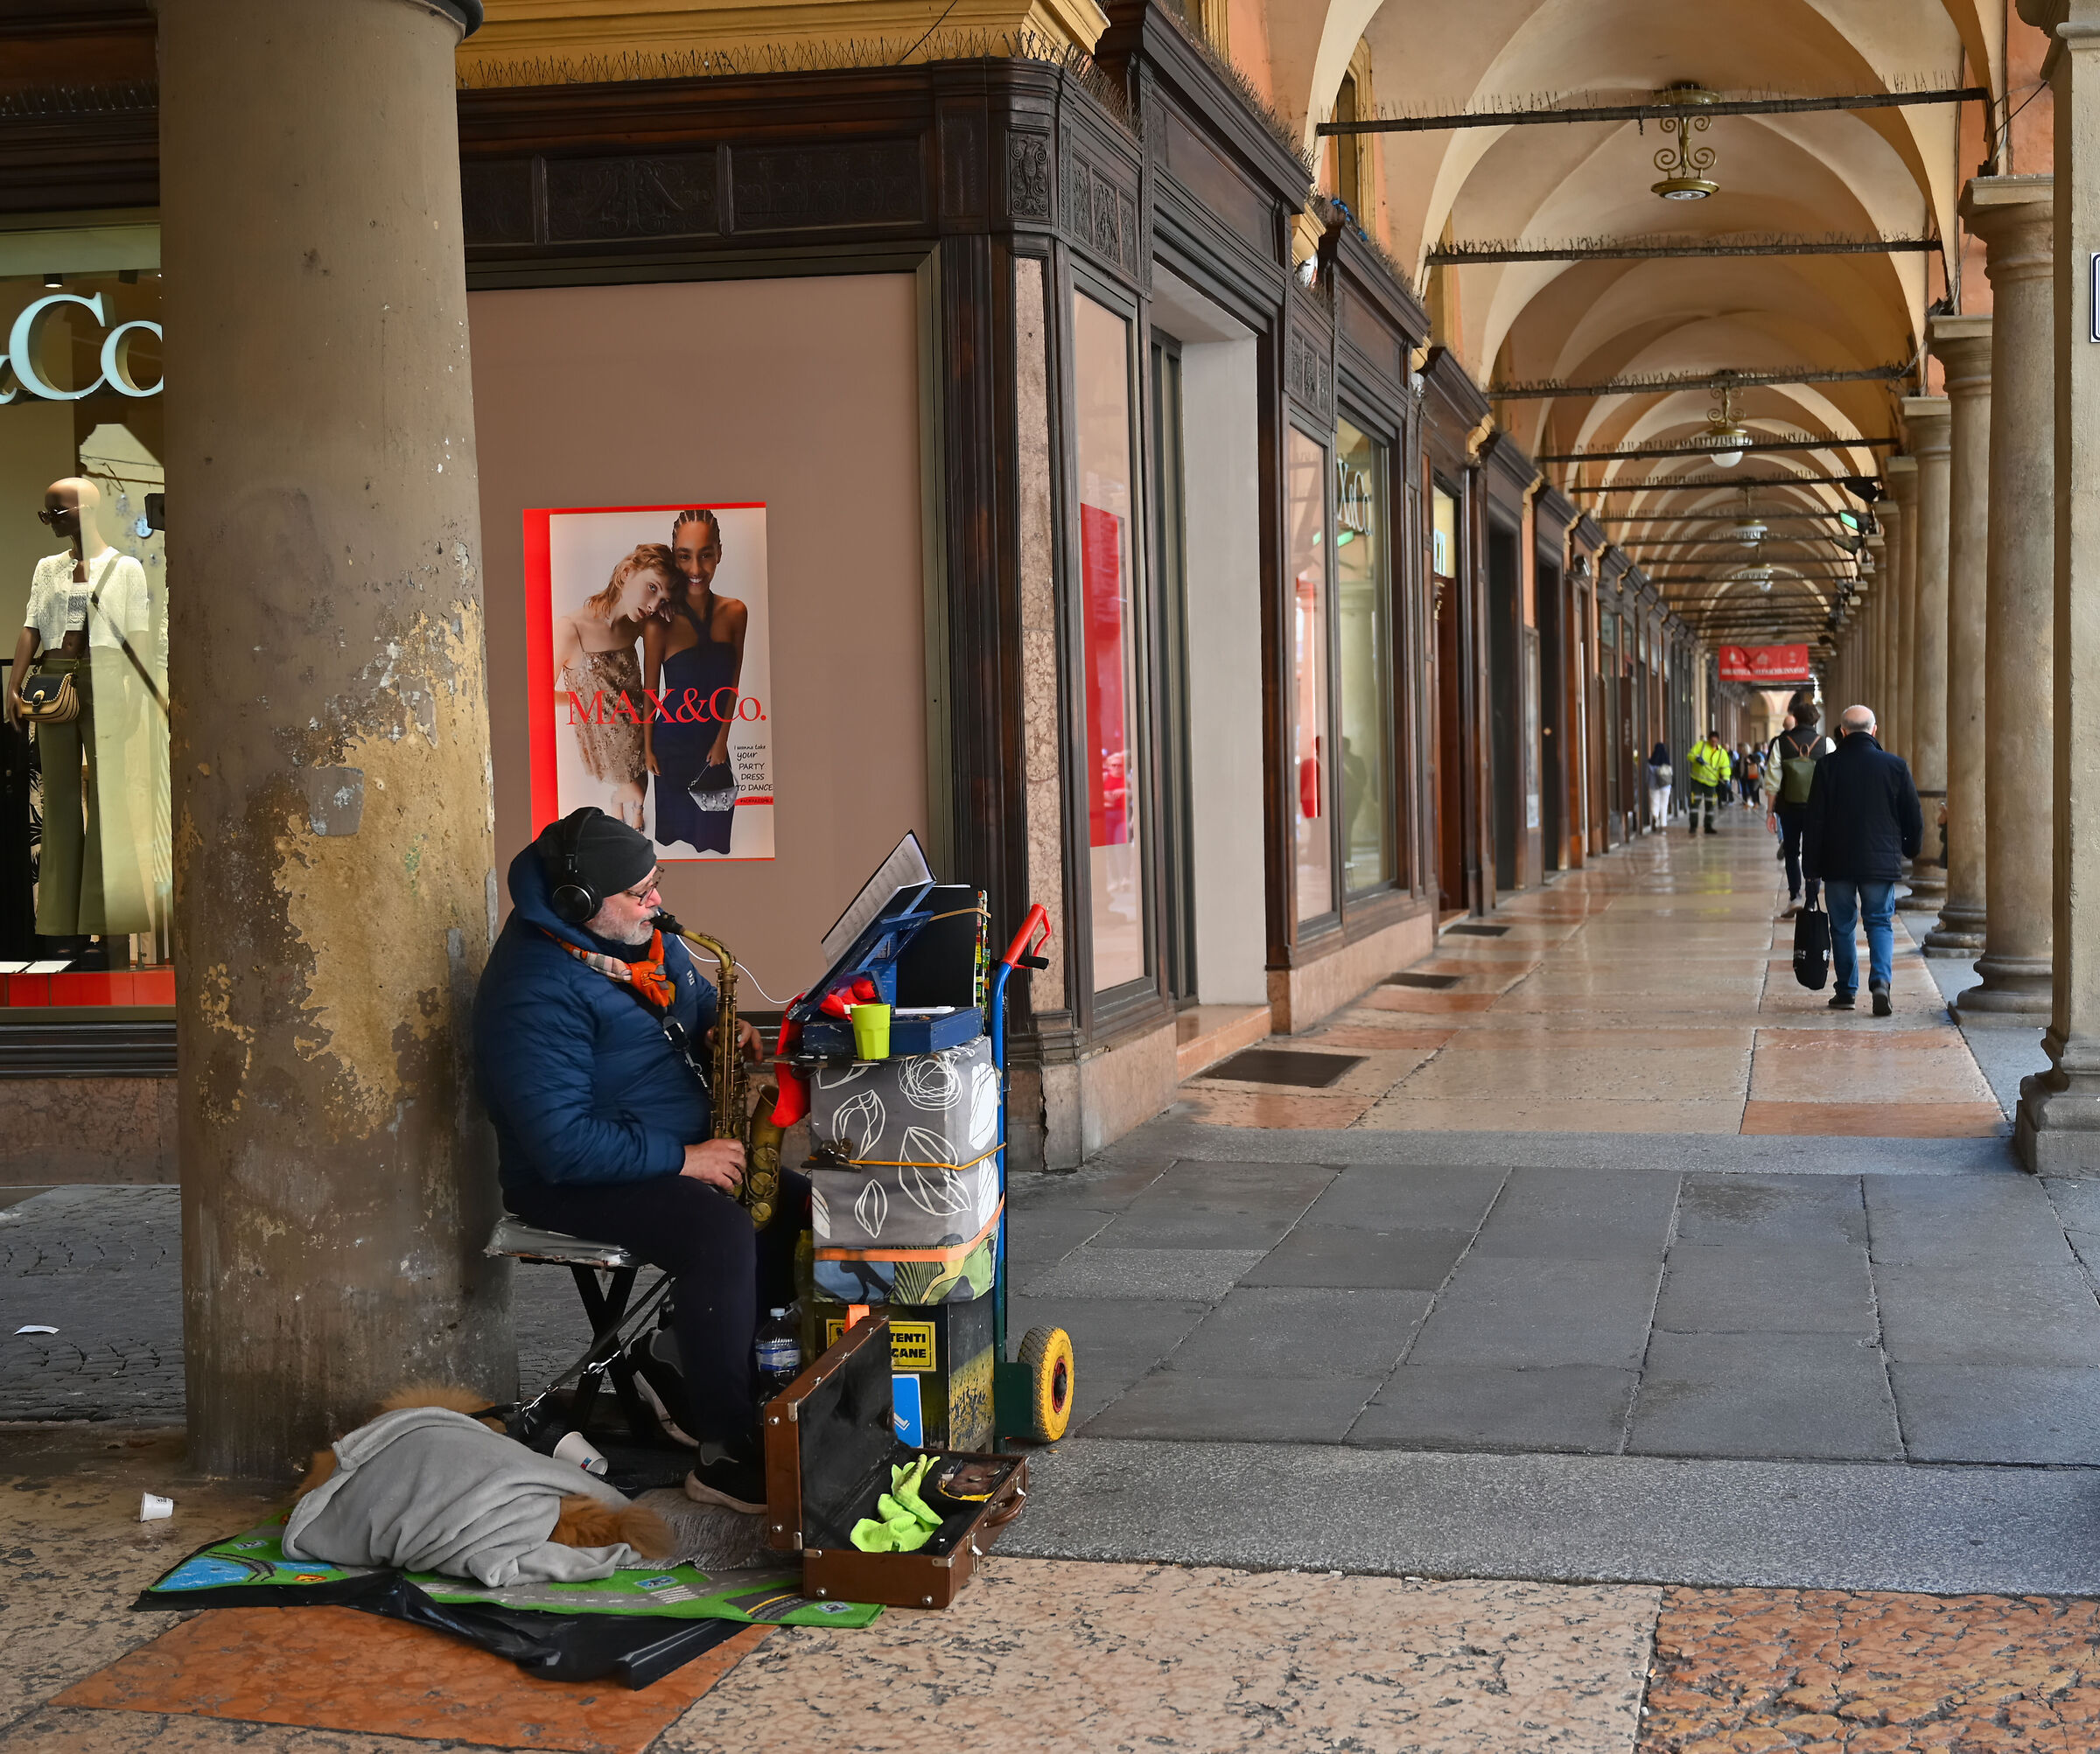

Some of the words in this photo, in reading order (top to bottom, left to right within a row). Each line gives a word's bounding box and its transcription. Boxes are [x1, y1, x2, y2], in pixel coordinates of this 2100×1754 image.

[0, 292, 164, 404] Co
[566, 687, 766, 725] MAX&Co.
[737, 751, 757, 761] your
[891, 1348, 927, 1358] CANE
